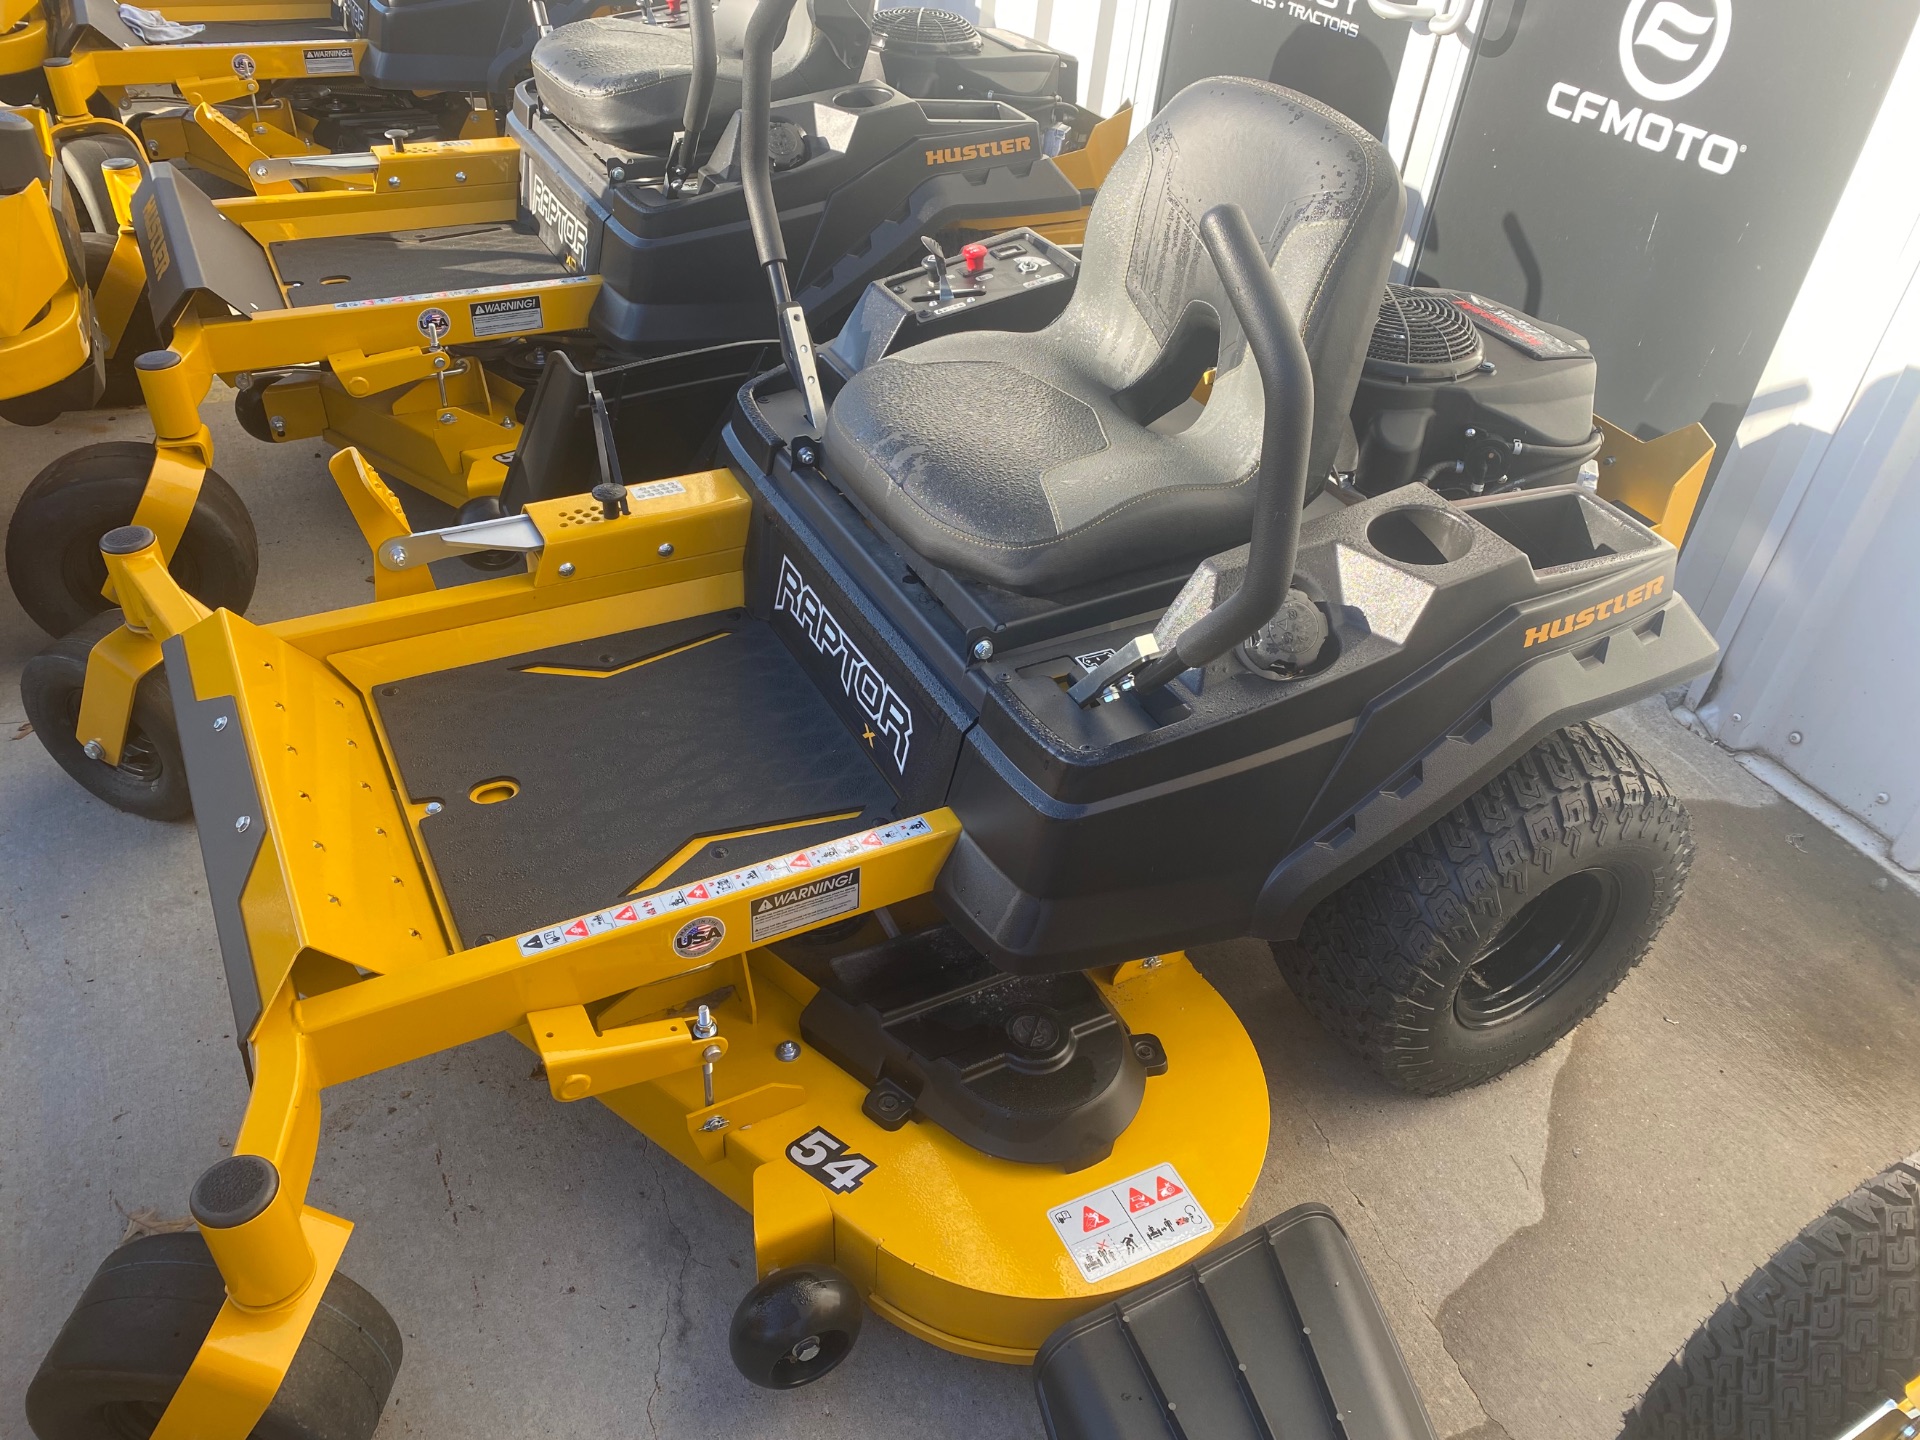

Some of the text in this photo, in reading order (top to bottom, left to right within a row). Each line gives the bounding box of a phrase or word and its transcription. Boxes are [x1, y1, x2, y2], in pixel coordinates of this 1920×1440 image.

[1287, 1, 1359, 37] TRACTORS
[925, 136, 1031, 166] HUSTLER
[142, 193, 170, 282] HUSTLER
[532, 173, 588, 272] RAPTOR
[484, 299, 536, 314] WARNING!
[1523, 575, 1665, 648] HUSTLER
[774, 554, 913, 775] RAPTOR
[862, 723, 876, 749] X
[774, 873, 854, 907] WARNING!
[677, 927, 722, 948] USA
[680, 922, 696, 936] MADE
[788, 1129, 873, 1191] 54
